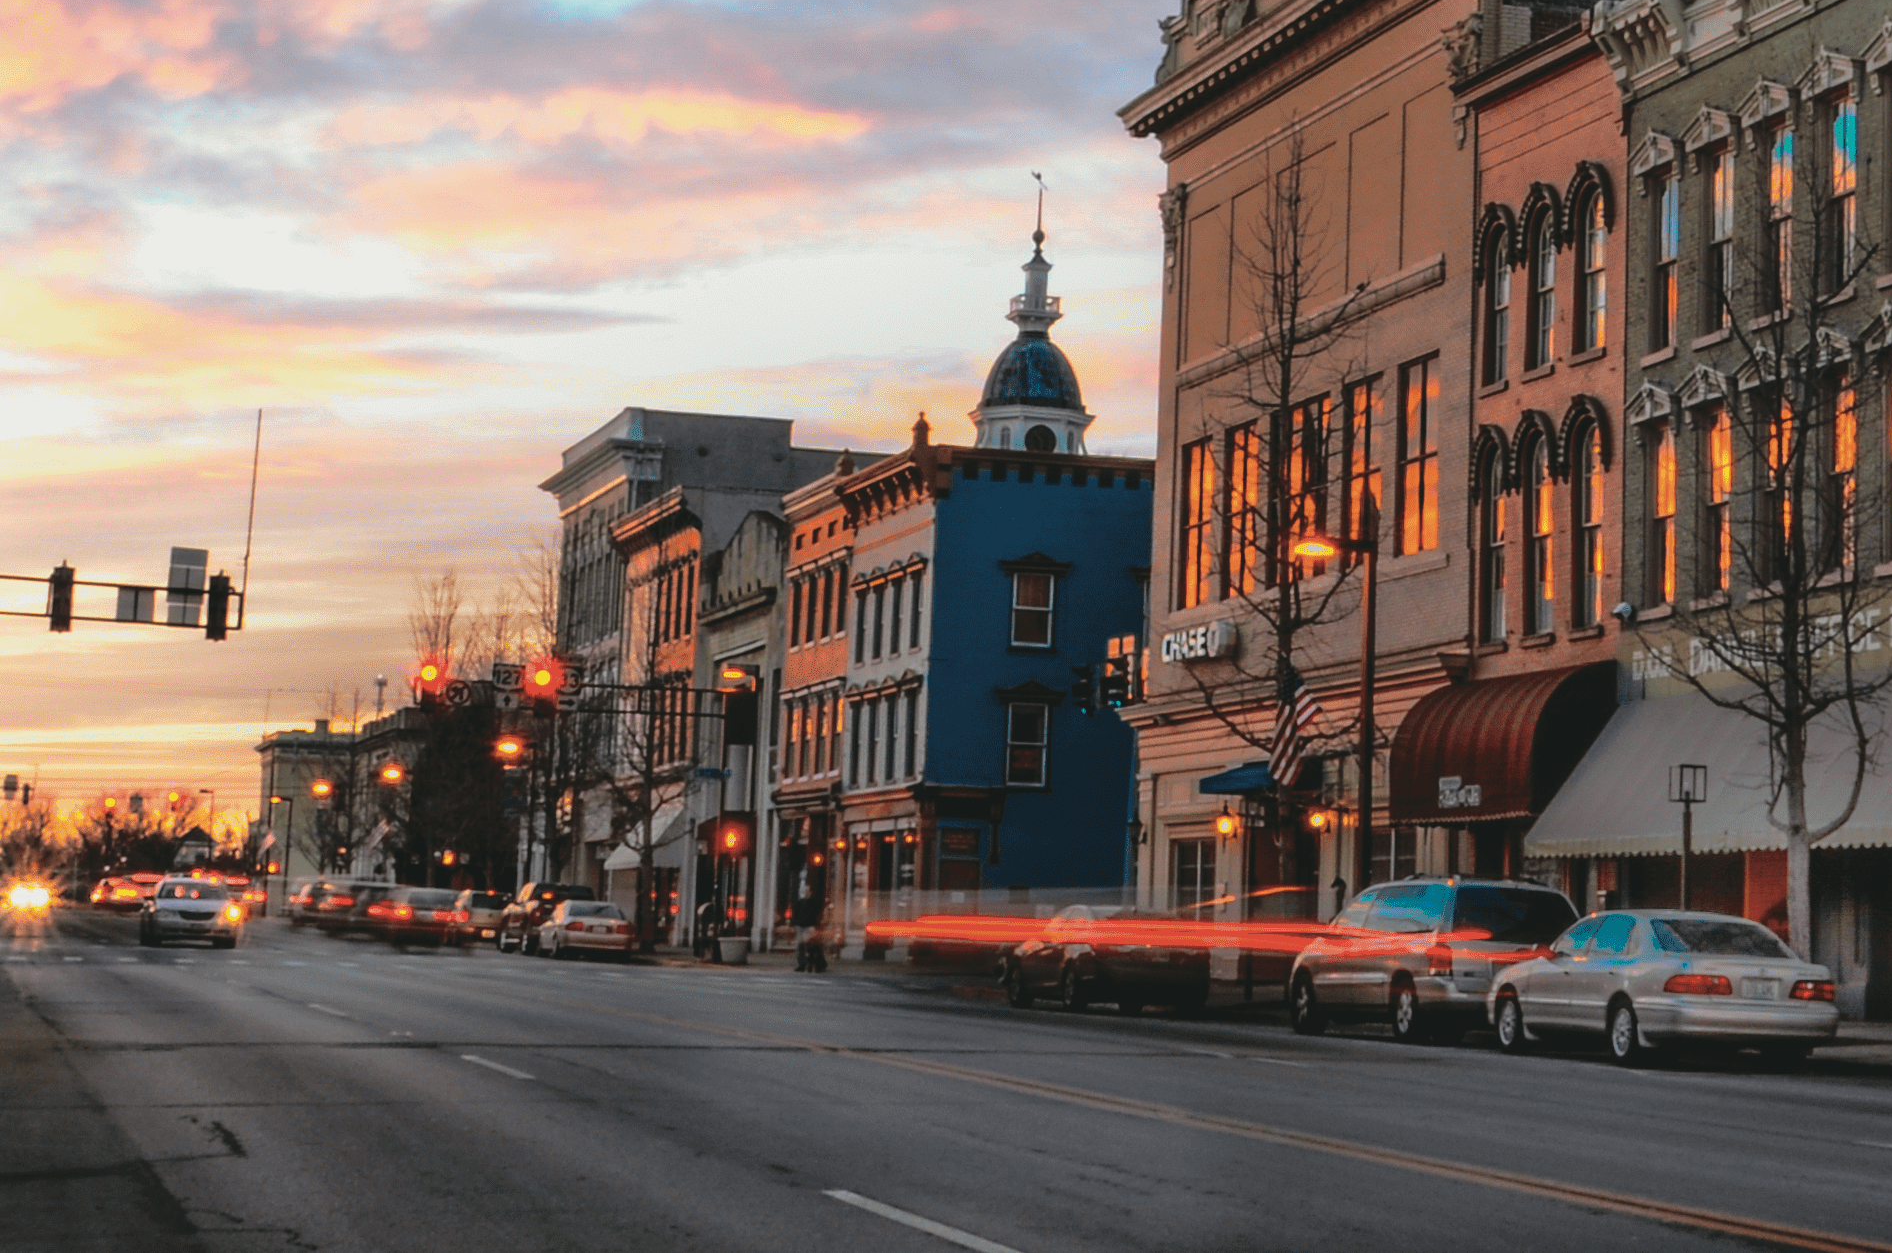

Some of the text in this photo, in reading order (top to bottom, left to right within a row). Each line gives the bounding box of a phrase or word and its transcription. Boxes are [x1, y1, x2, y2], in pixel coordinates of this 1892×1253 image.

[1161, 626, 1207, 663] CHASE
[1796, 608, 1881, 659] OFFCE
[496, 669, 522, 686] 127
